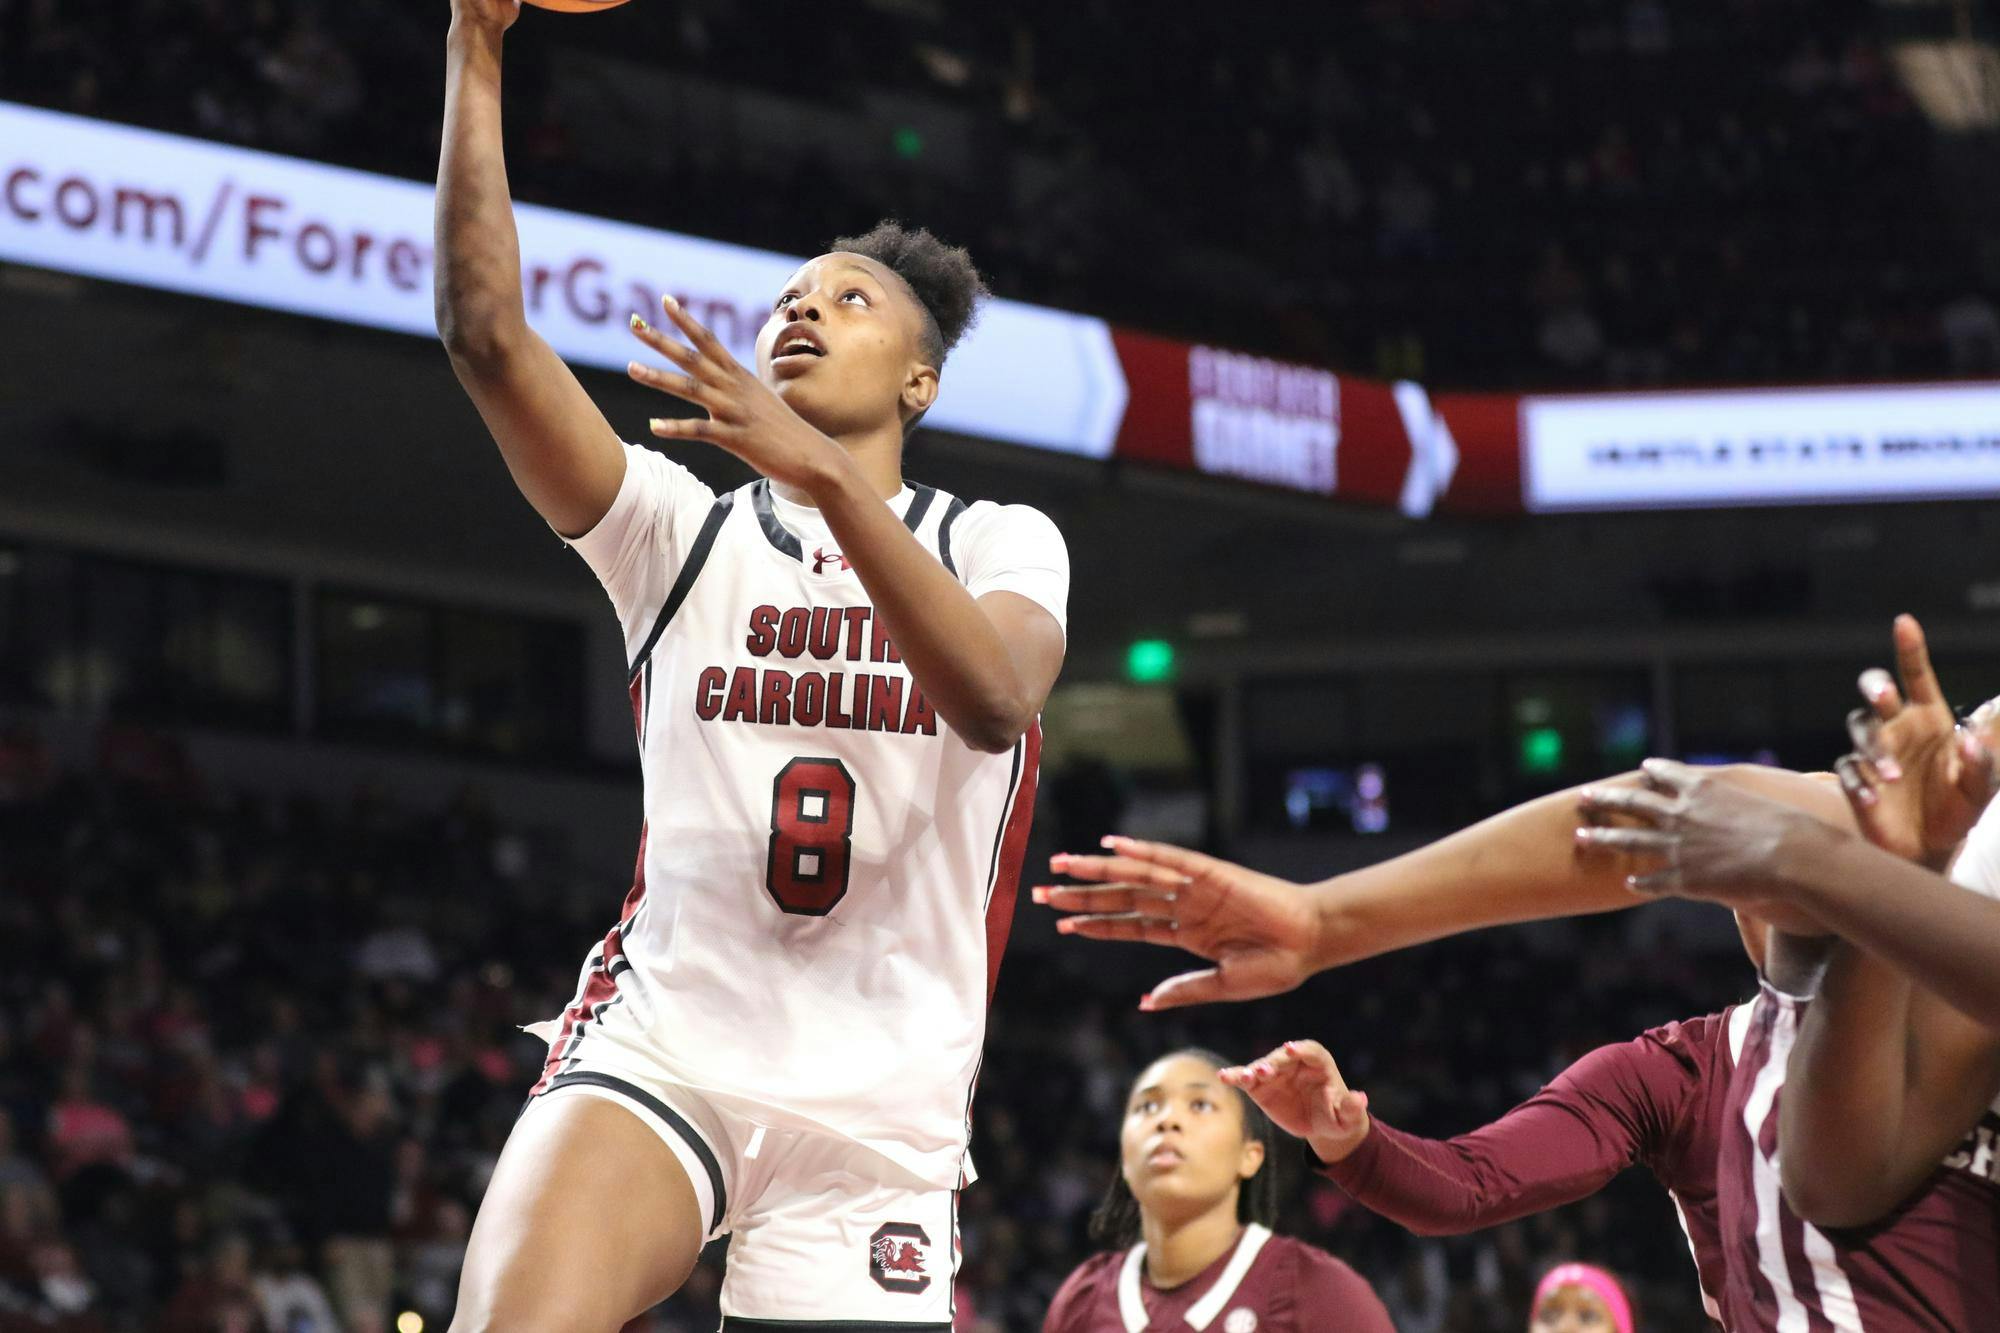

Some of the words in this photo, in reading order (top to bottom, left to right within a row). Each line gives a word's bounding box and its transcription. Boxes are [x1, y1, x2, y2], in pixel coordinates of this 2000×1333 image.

[746, 604, 902, 664] SOUTH
[695, 666, 938, 737] CAROLINA
[766, 756, 857, 917] 8
